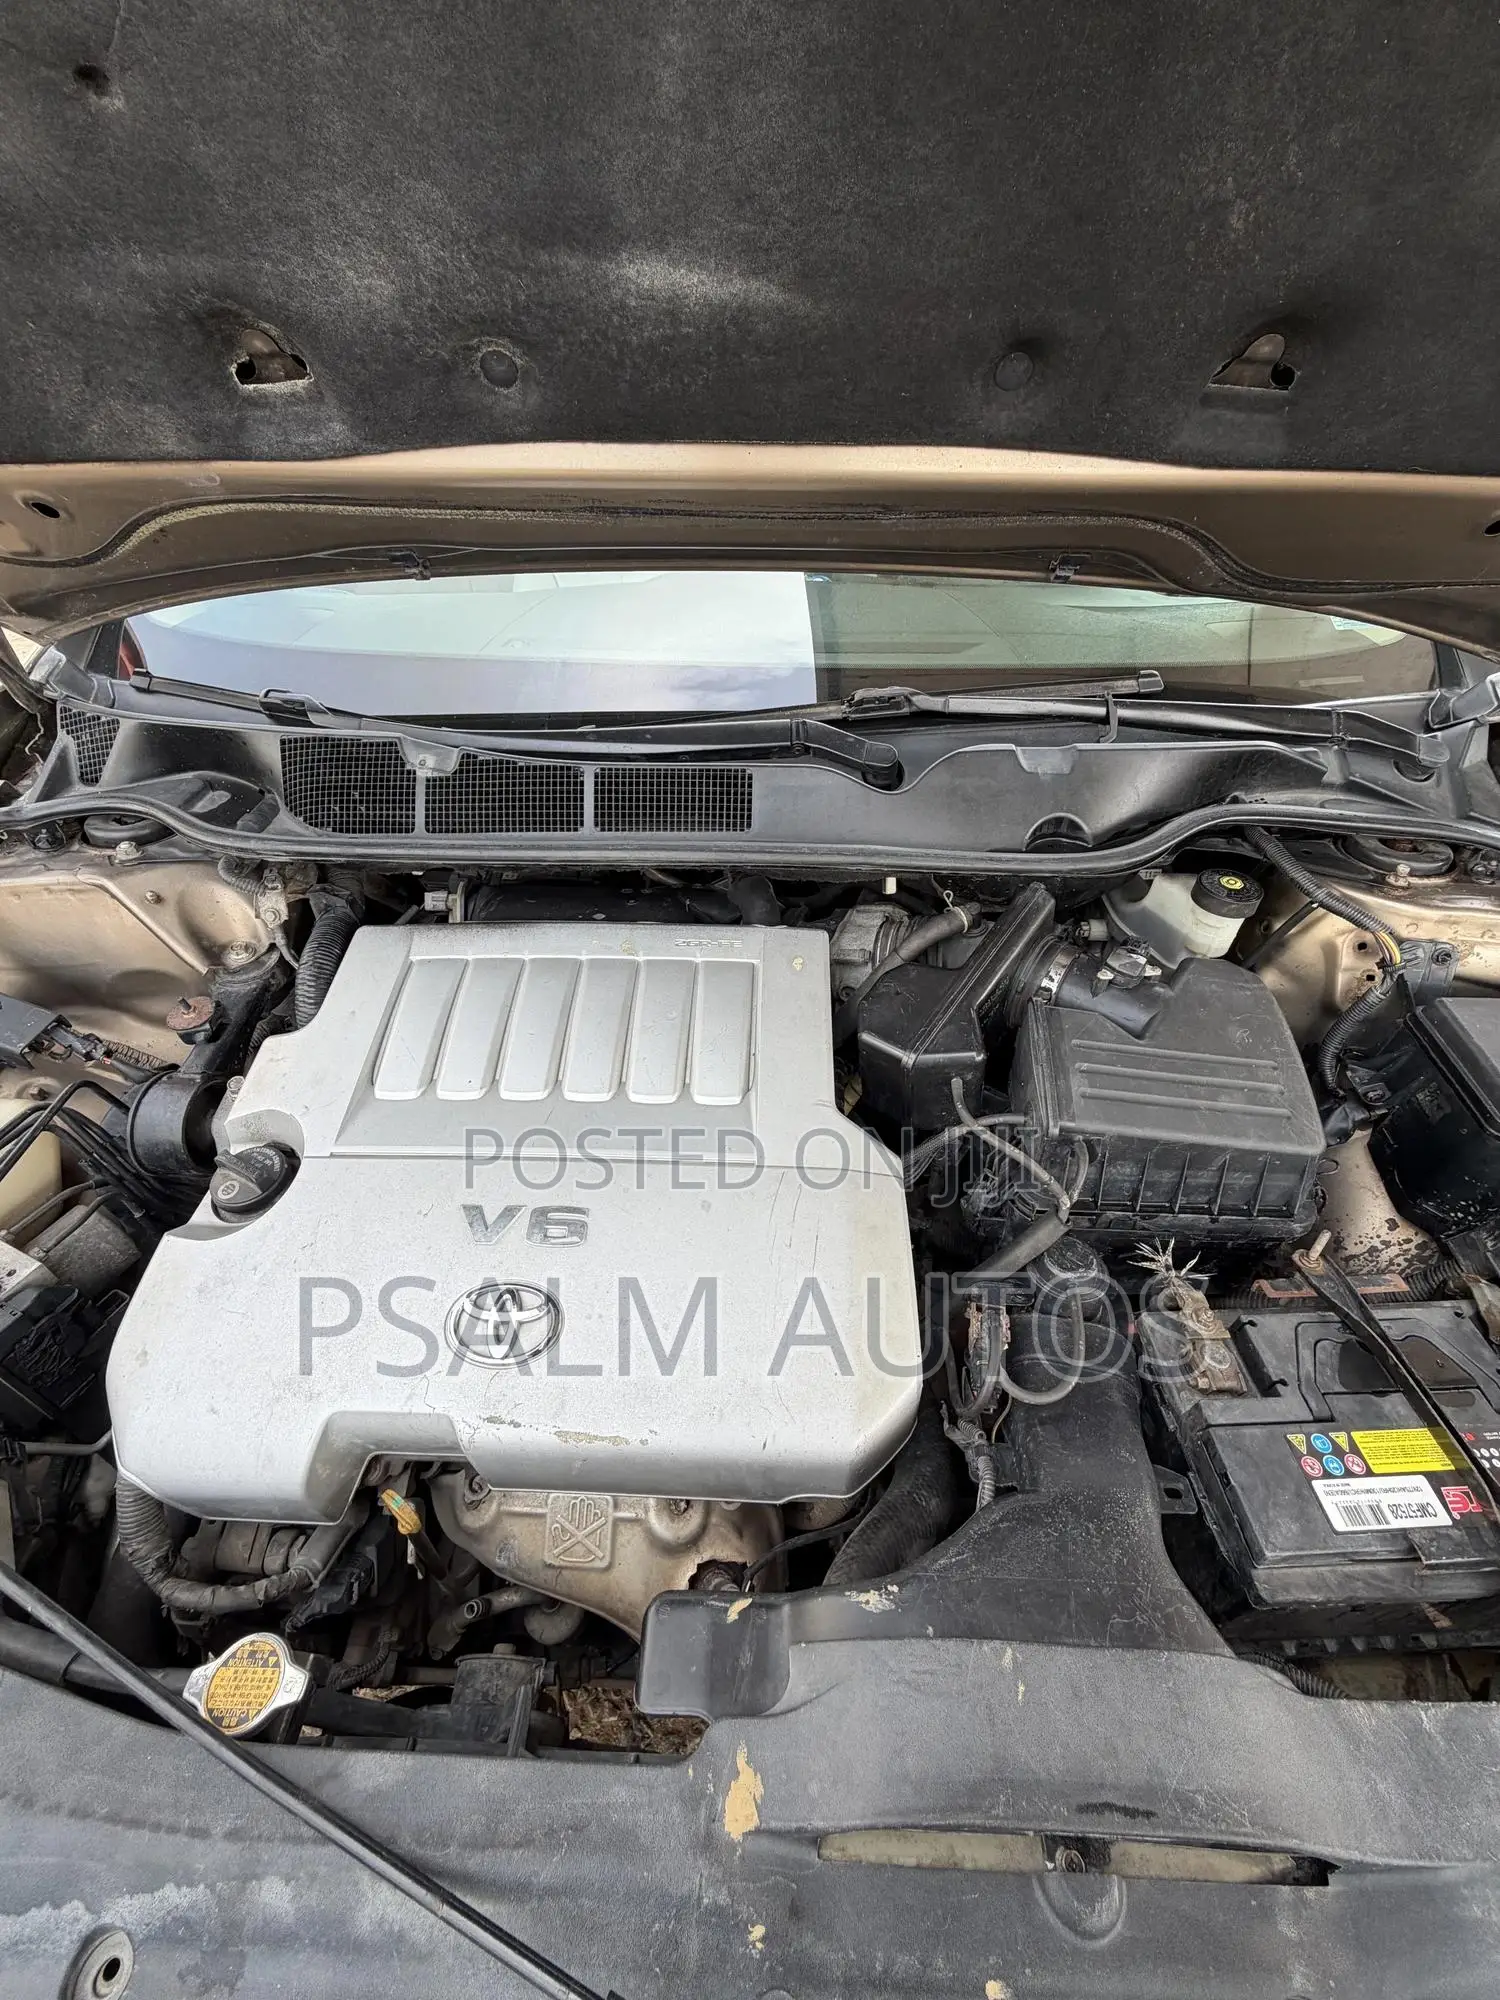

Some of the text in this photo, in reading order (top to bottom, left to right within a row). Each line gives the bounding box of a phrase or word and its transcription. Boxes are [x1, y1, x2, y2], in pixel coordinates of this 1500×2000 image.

[461, 1203, 590, 1248] V6
[1387, 1502, 1438, 1520] CMF57528
[212, 1708, 248, 1717] CAUTION
